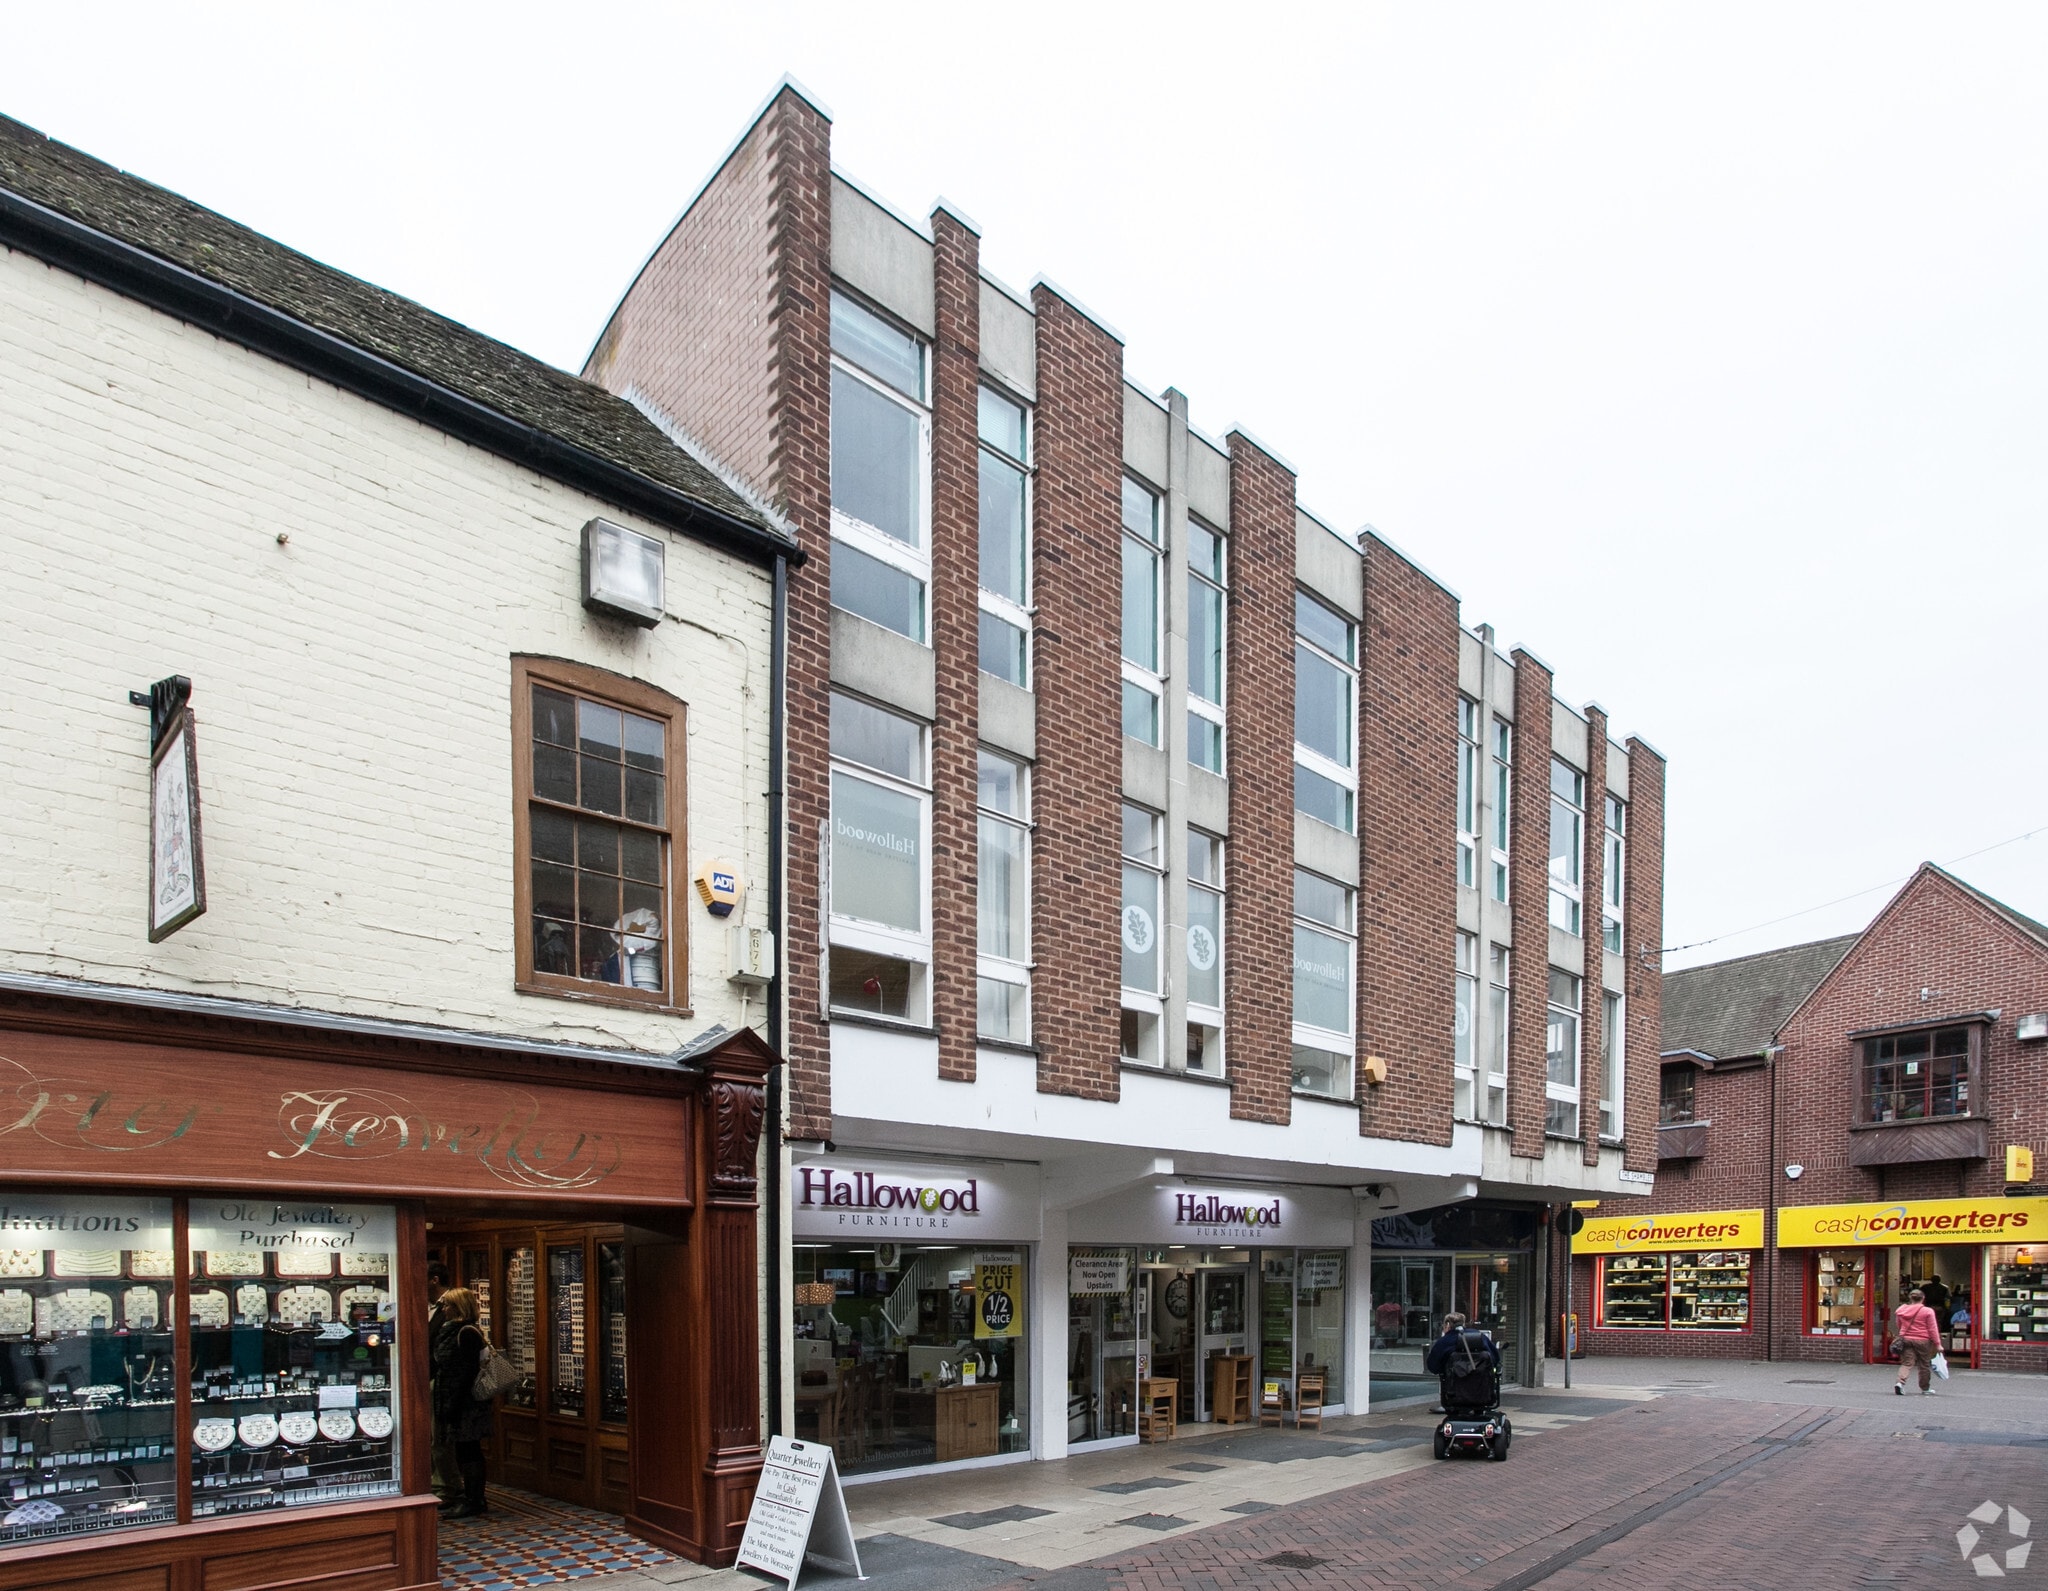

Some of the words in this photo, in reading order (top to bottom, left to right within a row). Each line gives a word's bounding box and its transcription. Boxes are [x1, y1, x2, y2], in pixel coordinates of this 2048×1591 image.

[713, 876, 735, 890] ADT
[799, 1167, 980, 1213] Hallowood
[1175, 1193, 1282, 1225] Hallowood
[266, 1205, 371, 1230] Jewellery
[838, 1214, 949, 1228] FURNITURE
[1197, 1228, 1262, 1237] FURNITURE
[1899, 1227, 2005, 1237] www.cashconverters.co.uk
[239, 1230, 355, 1249] Purchased
[1648, 1237, 1723, 1245] www.cashconverters.co.uk
[982, 1265, 1013, 1275] PRICE
[1075, 1260, 1107, 1268] Clearance
[1108, 1260, 1123, 1268] Area
[1082, 1270, 1097, 1279] Now
[1098, 1270, 1116, 1280] Open
[982, 1275, 1013, 1290] CUT
[1086, 1281, 1113, 1291] Upstairs
[988, 1294, 1008, 1315] 1/2
[986, 1314, 1011, 1324] PRICE
[768, 1449, 792, 1463] Quarter
[792, 1454, 823, 1472] Jewellery
[782, 1471, 790, 1479] The
[791, 1474, 801, 1482] Best
[783, 1483, 797, 1494] Cash
[747, 1536, 756, 1545] The
[757, 1539, 768, 1549] Most
[769, 1544, 795, 1560] Reasonable
[742, 1547, 762, 1561] Jewellers
[771, 1556, 793, 1572] Worcester
